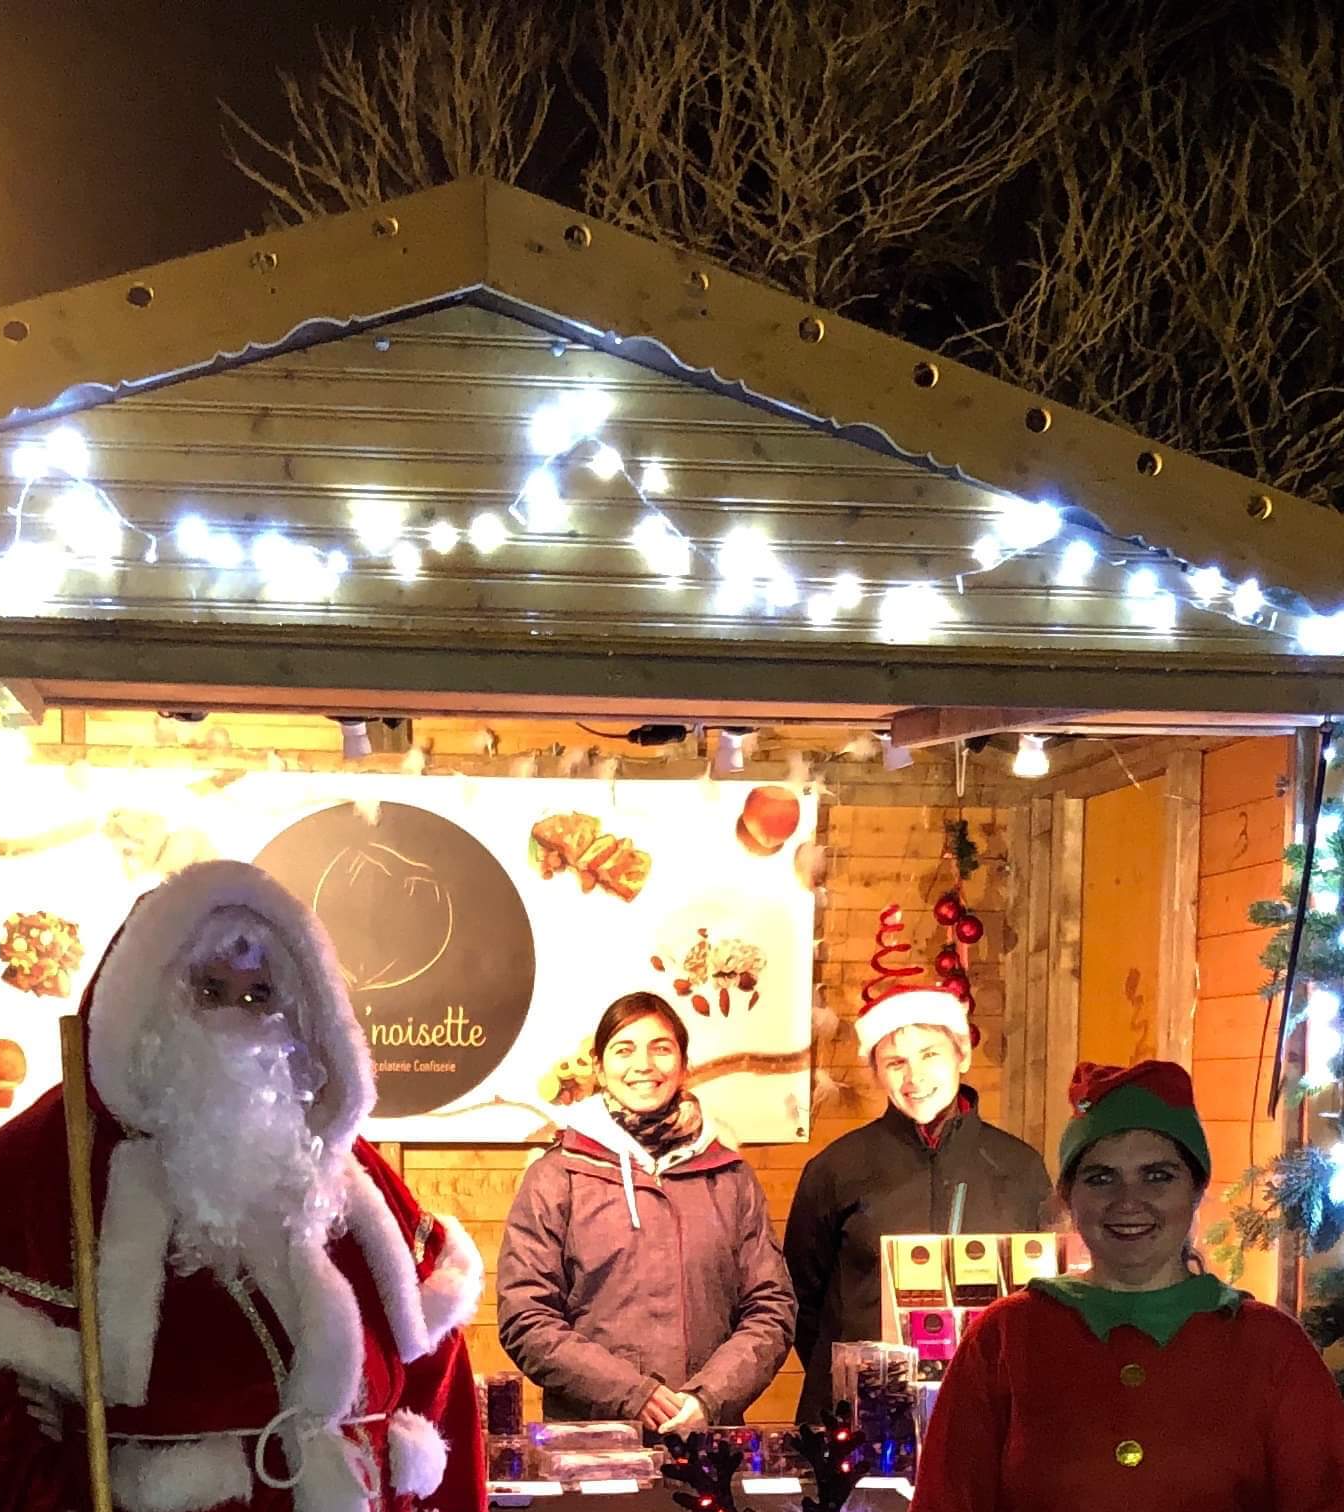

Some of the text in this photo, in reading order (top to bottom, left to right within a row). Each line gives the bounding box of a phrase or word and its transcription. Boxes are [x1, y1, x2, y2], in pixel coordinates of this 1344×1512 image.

[365, 1005, 486, 1046] 'noisette
[372, 1058, 456, 1072] colaterie Confiserie
